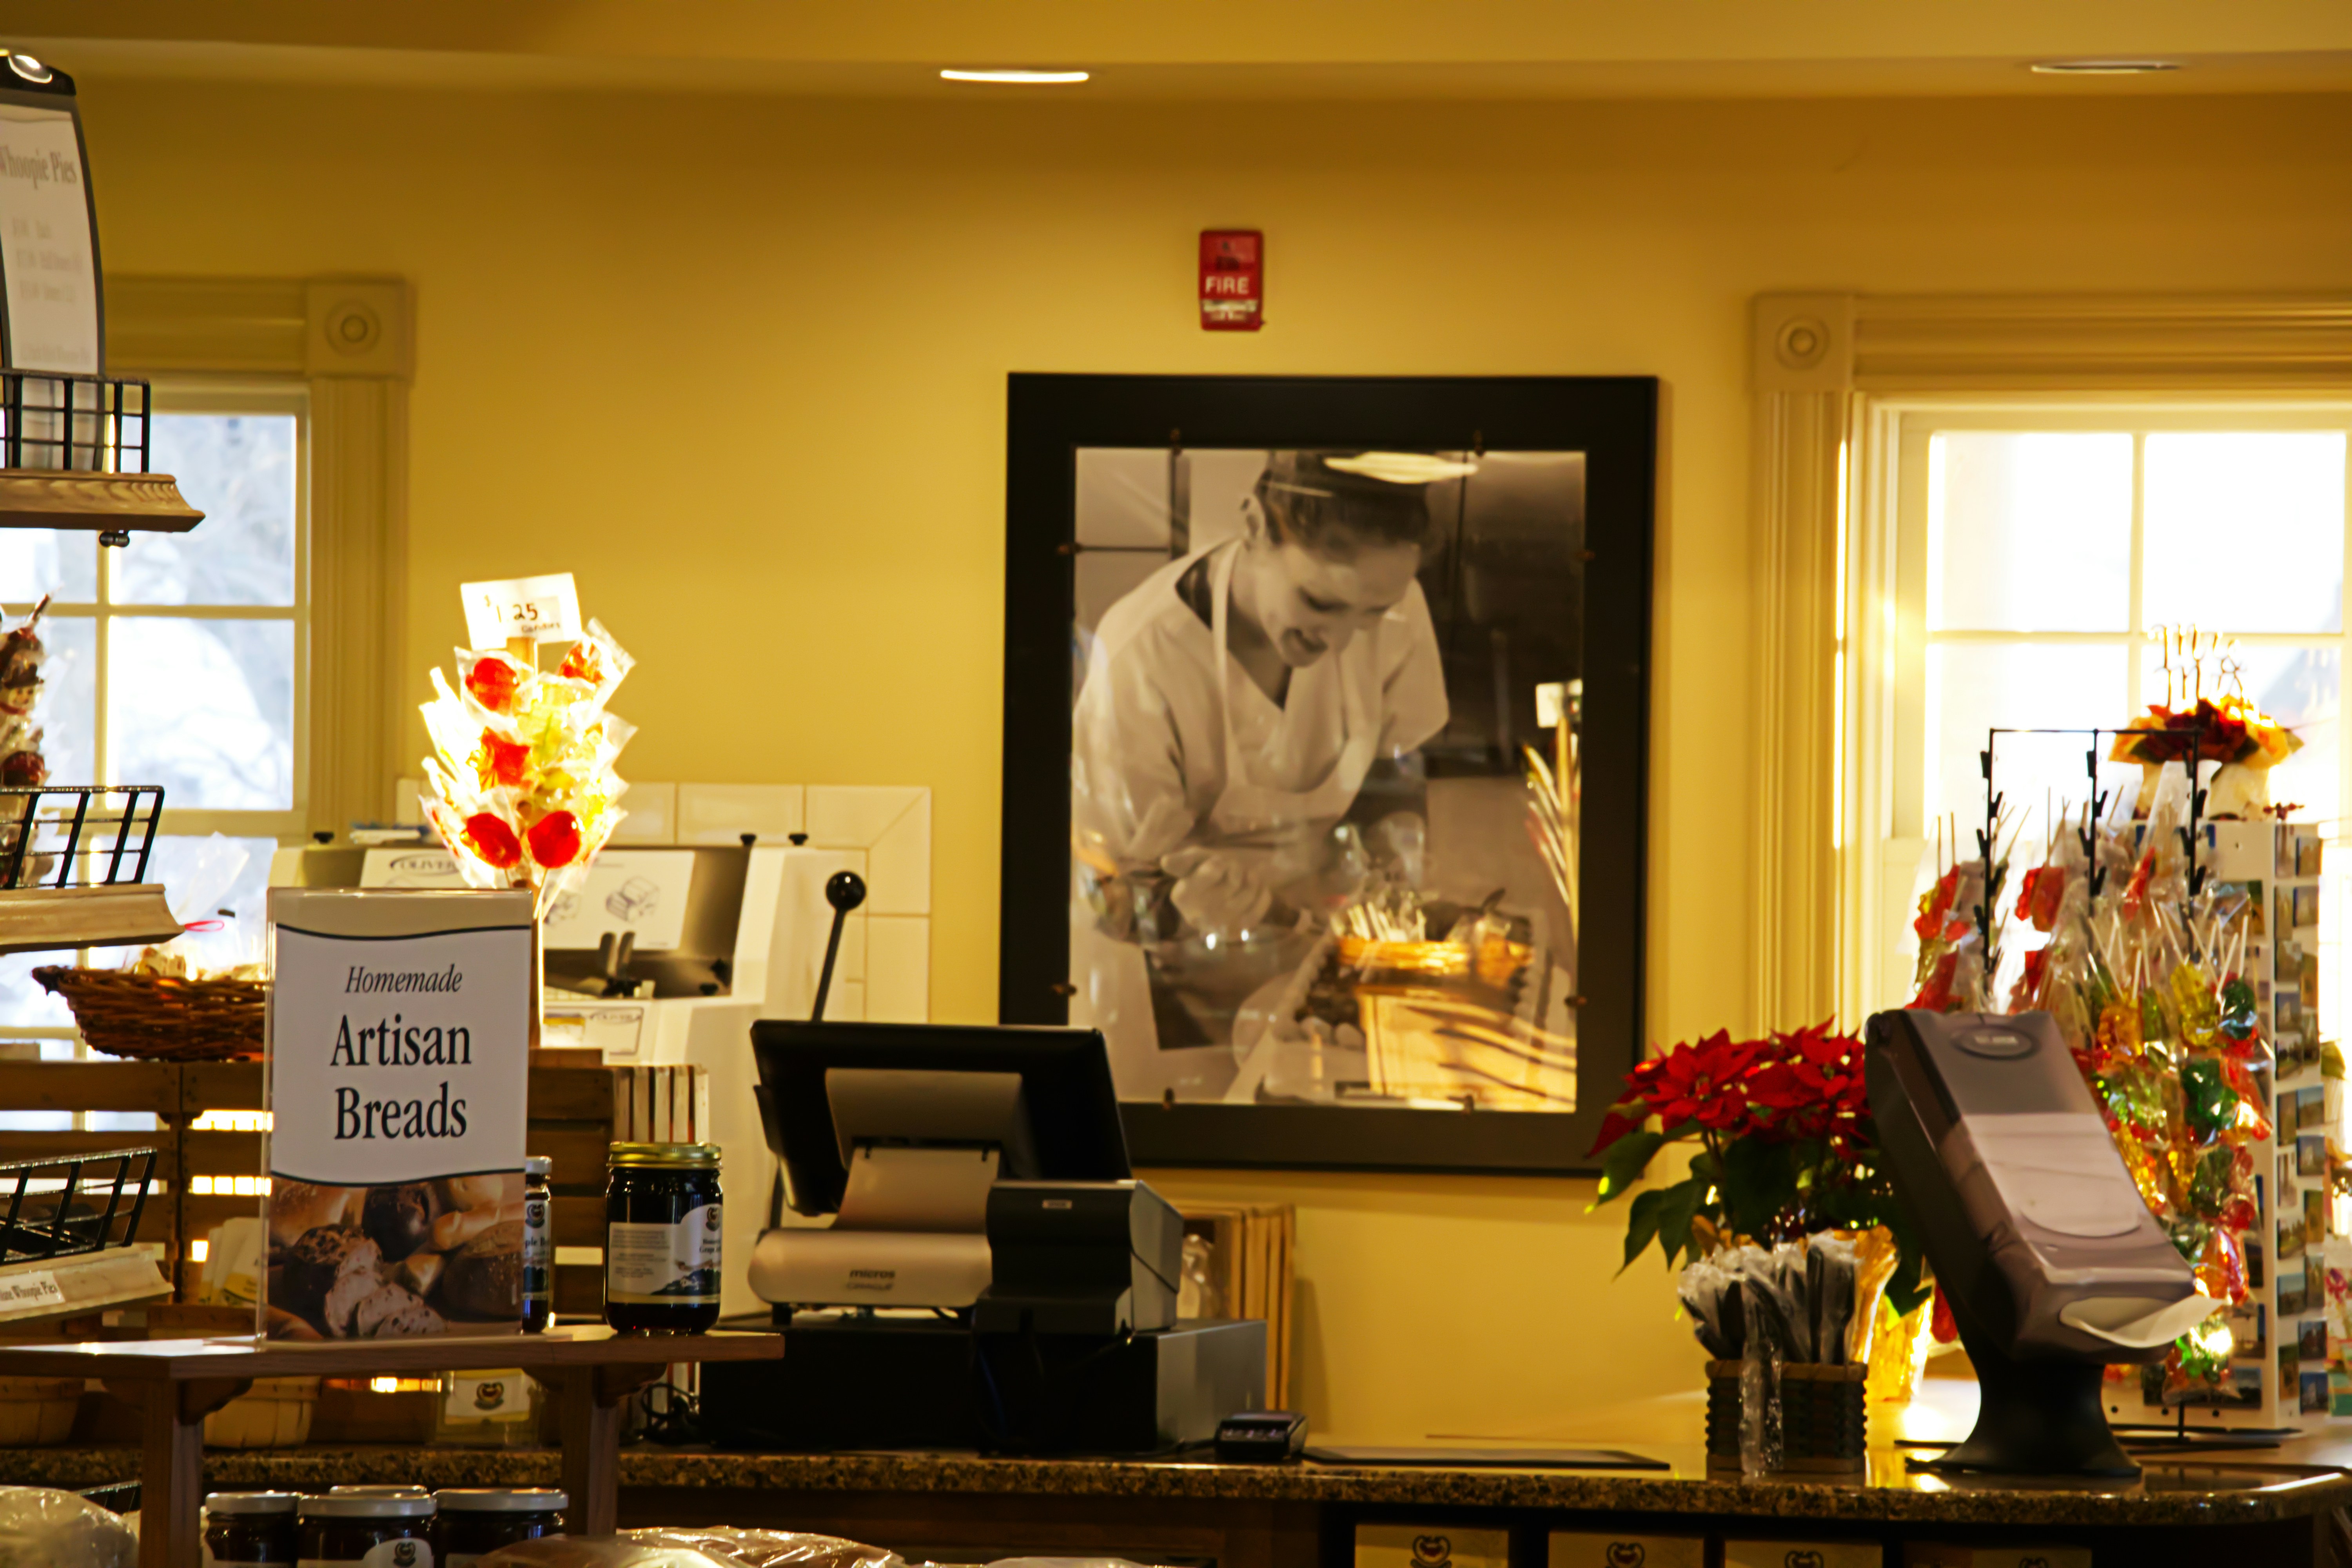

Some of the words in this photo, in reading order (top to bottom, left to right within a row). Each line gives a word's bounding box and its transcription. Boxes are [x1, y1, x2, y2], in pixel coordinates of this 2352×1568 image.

[50, 151, 77, 185] Pies
[1205, 276, 1249, 294] FIRE
[345, 963, 463, 993] Homemade
[330, 1013, 472, 1066] Artisan
[334, 1081, 467, 1140] Breads
